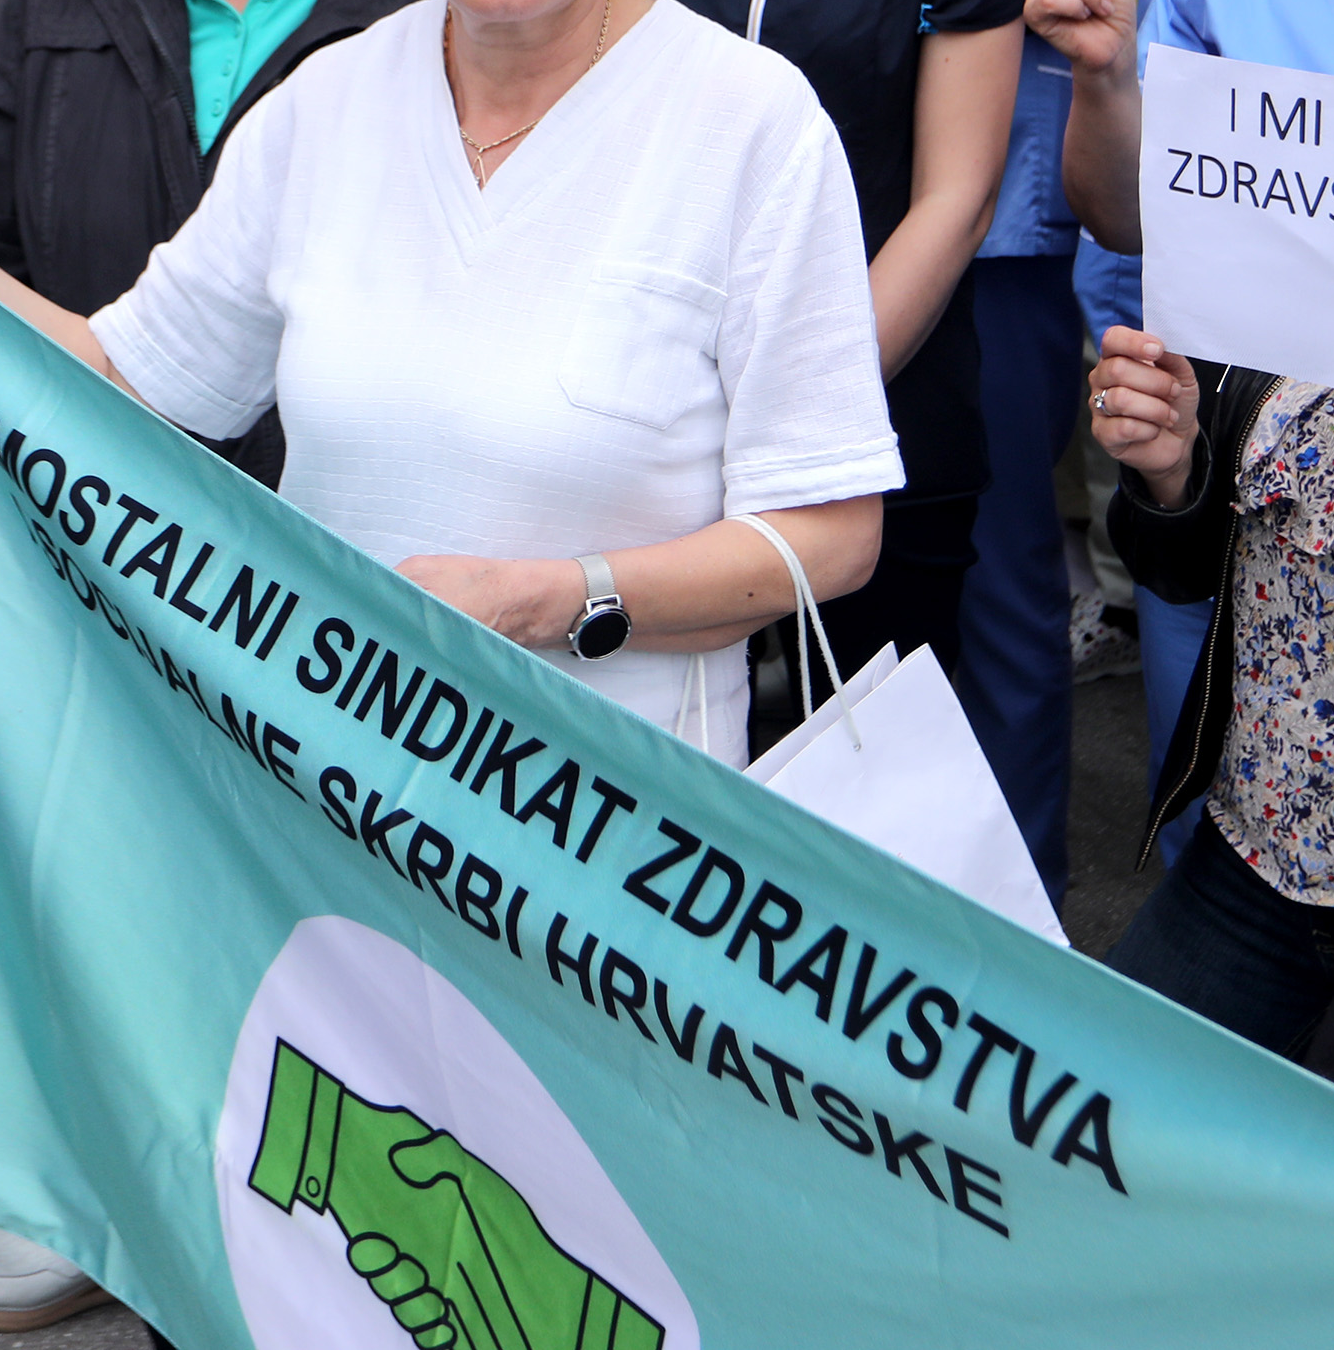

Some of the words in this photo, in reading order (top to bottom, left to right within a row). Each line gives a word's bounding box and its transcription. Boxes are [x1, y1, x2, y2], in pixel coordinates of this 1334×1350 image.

[1229, 86, 1237, 133] I
[1260, 91, 1323, 148] MI
[296, 616, 638, 865] SINDIKAT
[622, 816, 1129, 1196] ZDRAVSTVA
[319, 765, 530, 960] SKRBI
[545, 911, 1010, 1240] HRVATSKE
